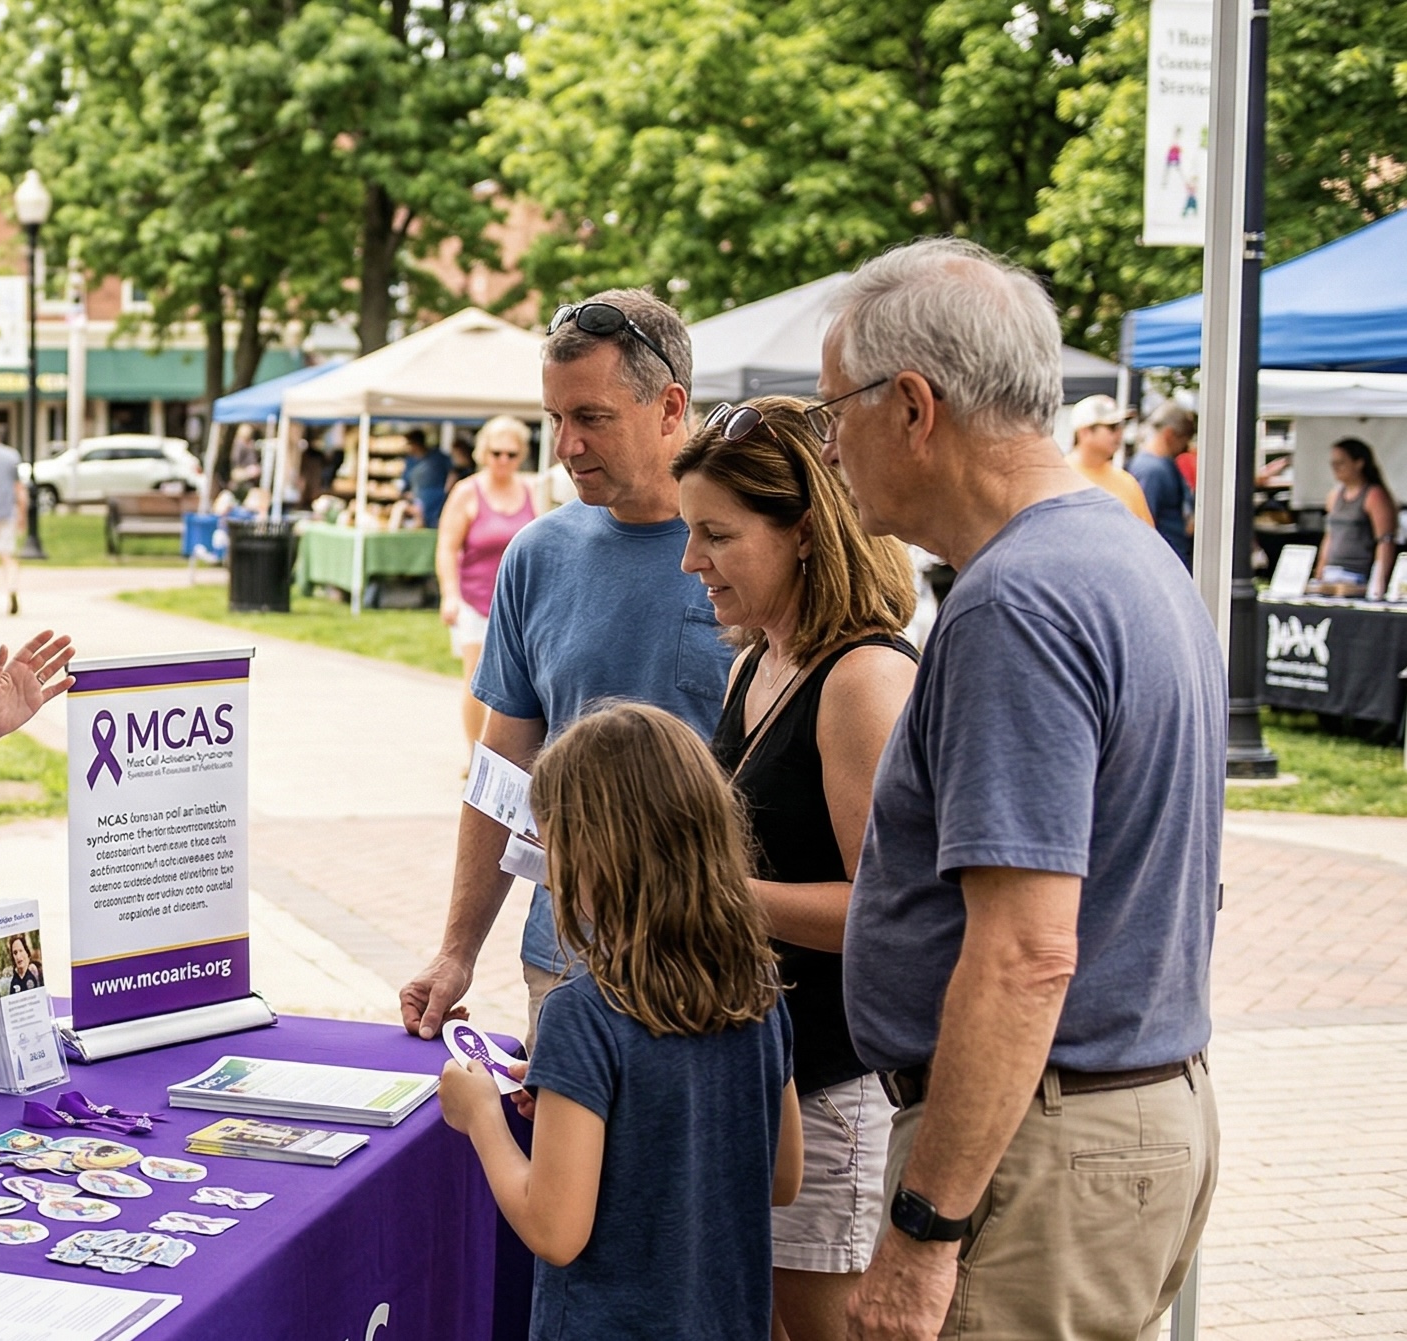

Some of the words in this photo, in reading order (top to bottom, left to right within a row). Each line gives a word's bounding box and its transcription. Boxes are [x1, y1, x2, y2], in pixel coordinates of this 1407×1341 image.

[127, 703, 234, 753] MCAS
[97, 813, 128, 827] MCAS
[86, 831, 135, 848] syndrome
